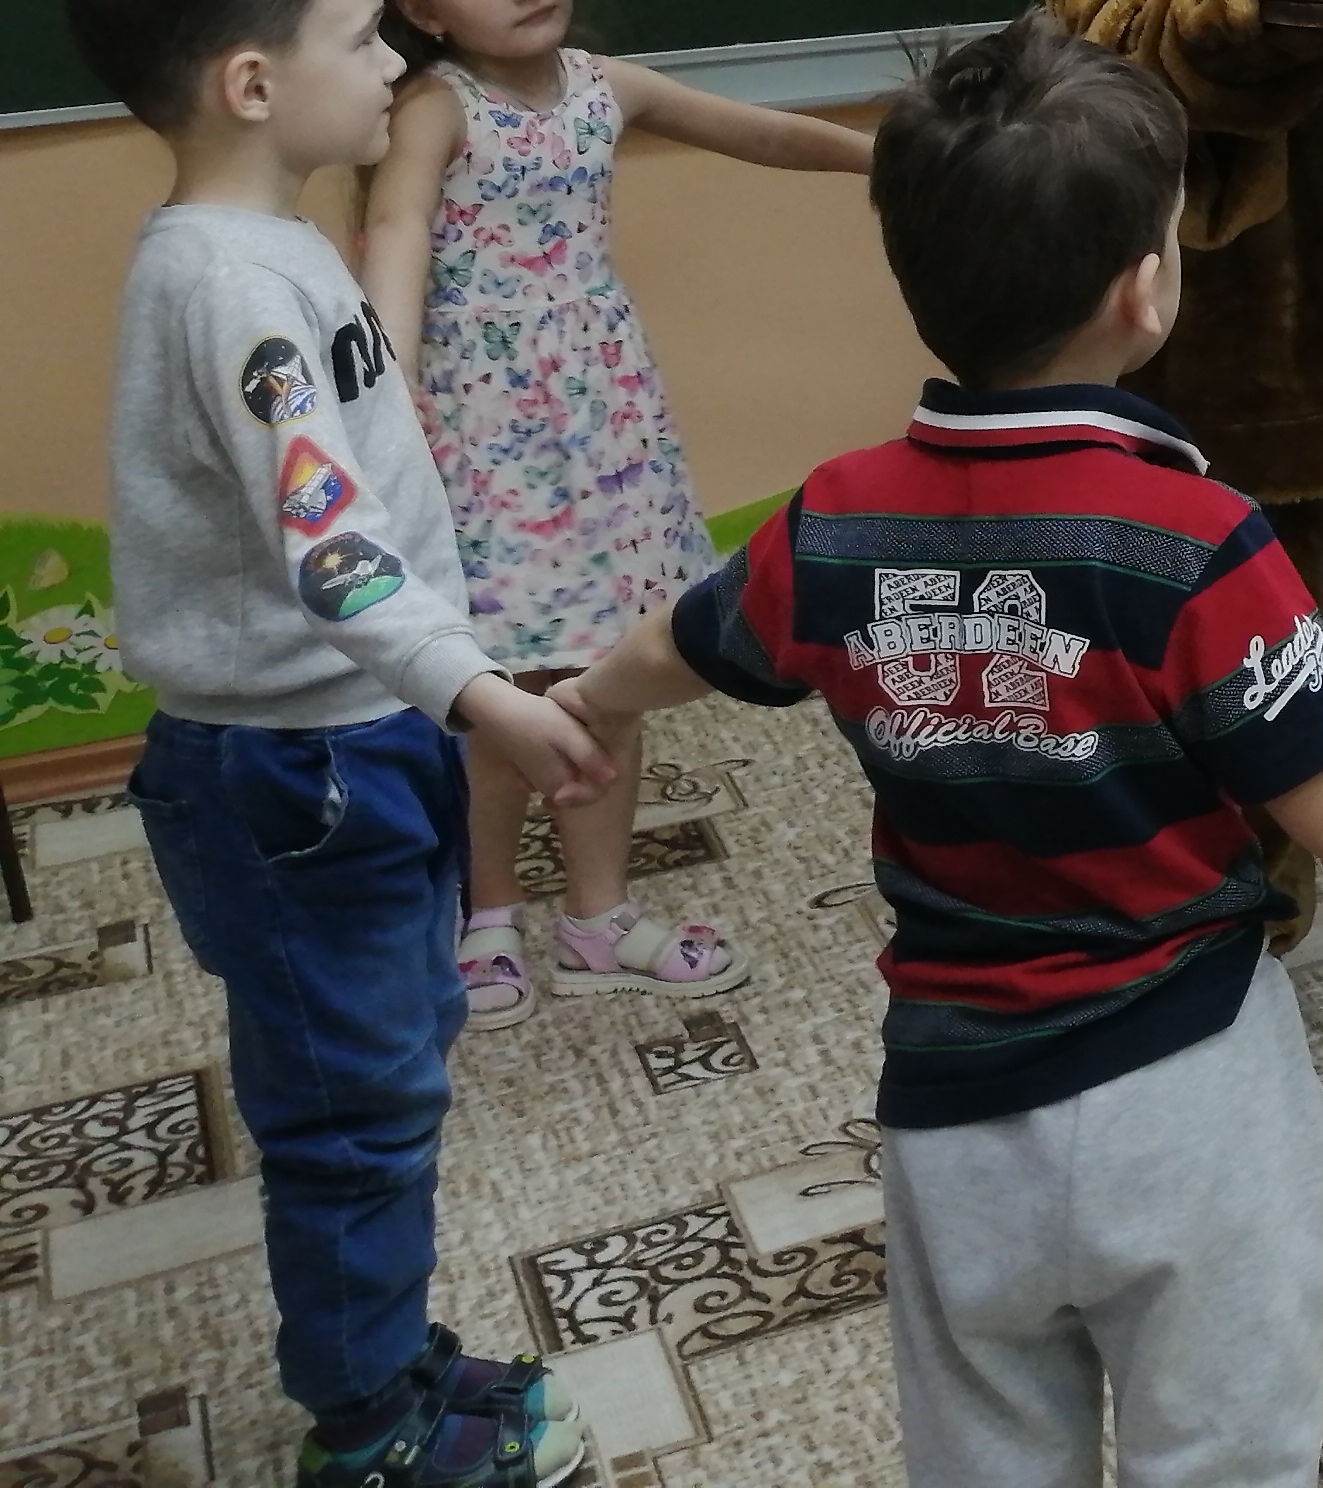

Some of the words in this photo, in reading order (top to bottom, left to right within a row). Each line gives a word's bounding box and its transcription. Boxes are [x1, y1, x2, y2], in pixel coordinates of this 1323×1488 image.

[843, 613, 1090, 678] ABERDEEN
[865, 706, 1017, 761] Official
[1013, 716, 1099, 760] Base
